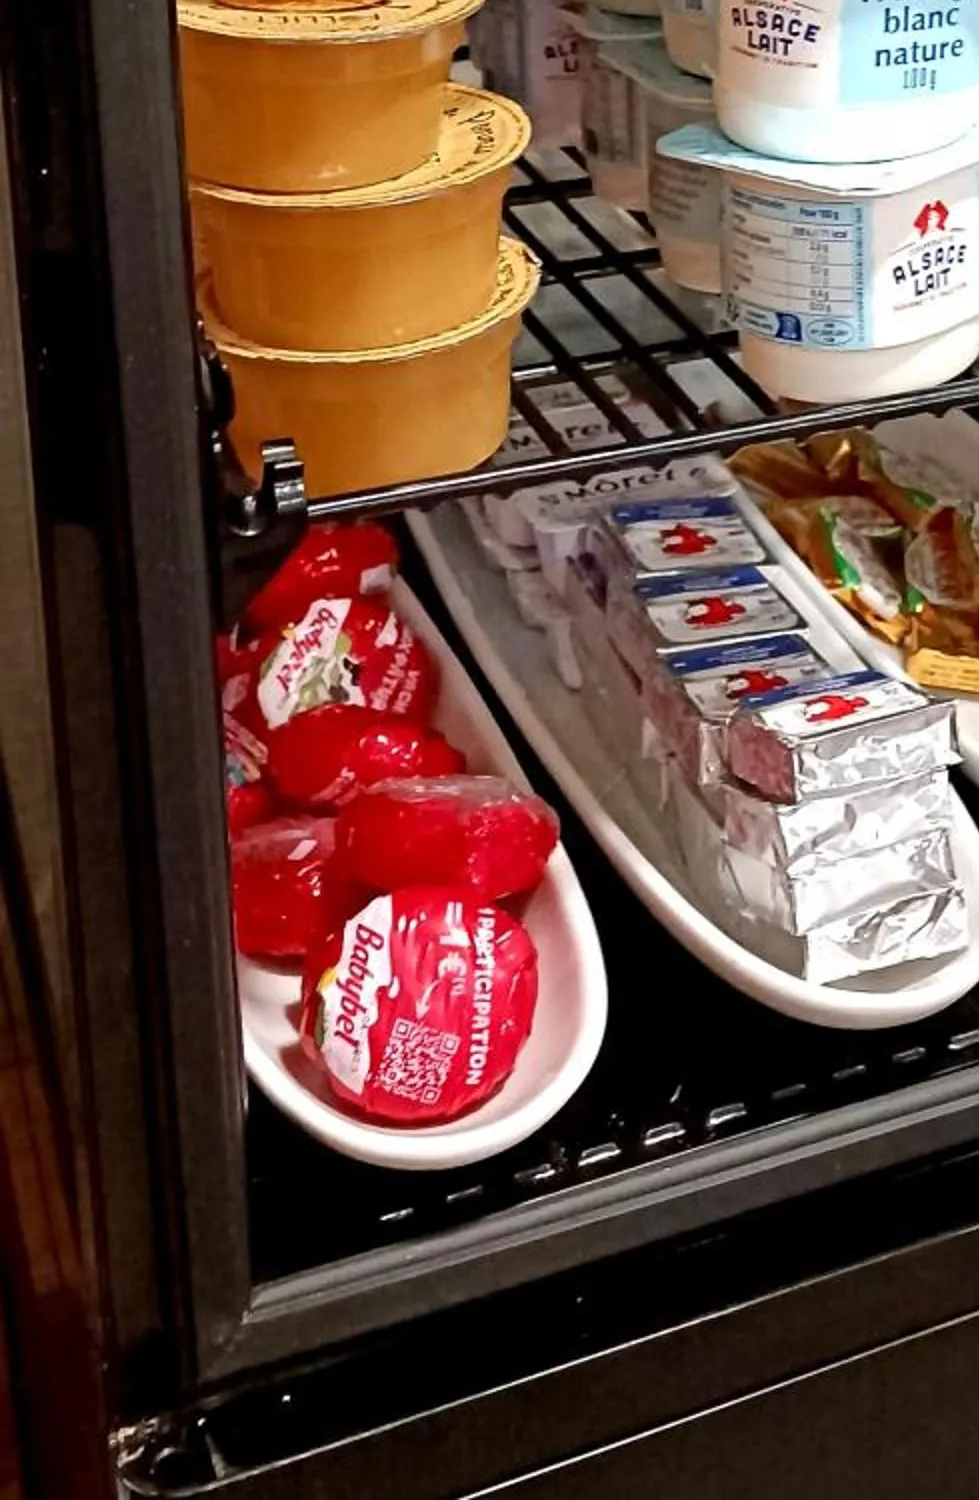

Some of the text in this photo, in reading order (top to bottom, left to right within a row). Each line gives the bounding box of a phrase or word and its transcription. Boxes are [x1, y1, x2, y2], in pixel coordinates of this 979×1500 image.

[731, 7, 821, 43] ALSACE
[883, 5, 960, 34] blanc
[747, 29, 794, 56] LAIT
[874, 38, 964, 68] nature
[892, 244, 968, 285] ALSACE
[914, 267, 951, 297] LAIT
[333, 923, 386, 1050] Babybel
